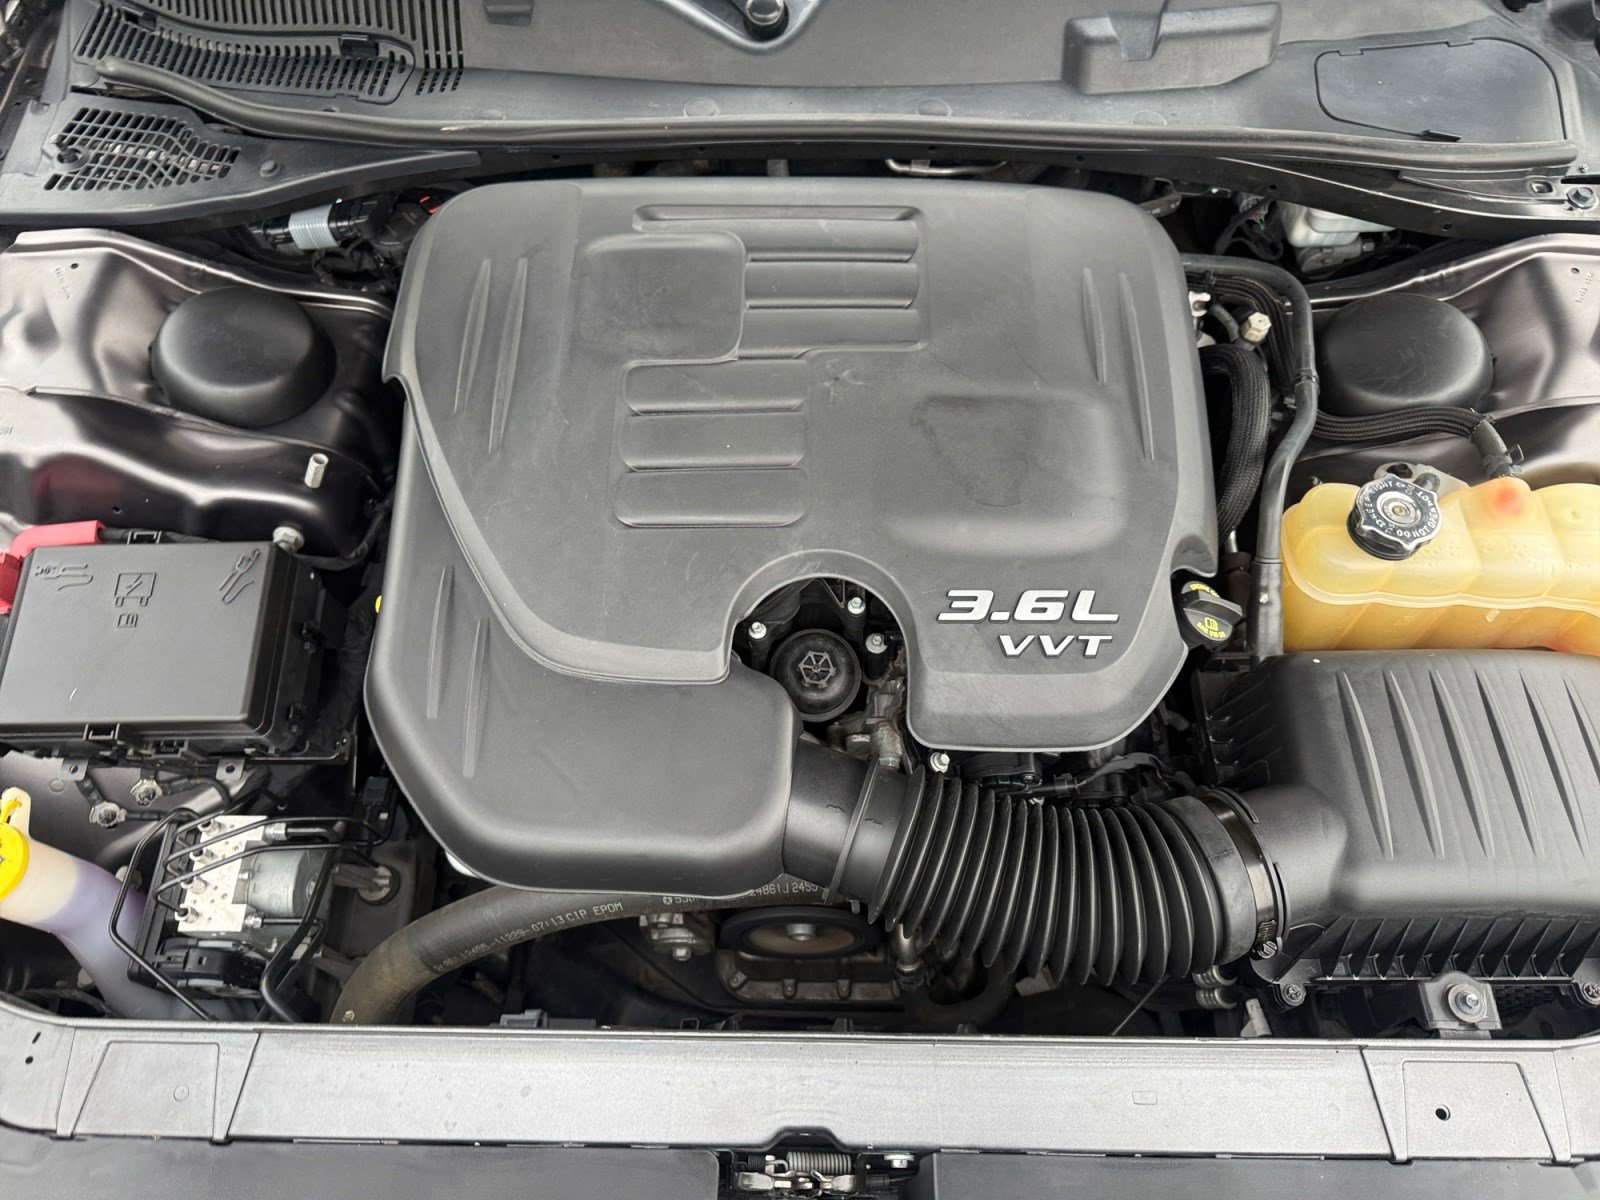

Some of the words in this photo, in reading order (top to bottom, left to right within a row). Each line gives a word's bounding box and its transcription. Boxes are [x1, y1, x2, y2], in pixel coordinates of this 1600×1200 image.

[937, 588, 1120, 624] 3.6L
[997, 634, 1113, 659] VVT
[592, 901, 624, 917] EPDM
